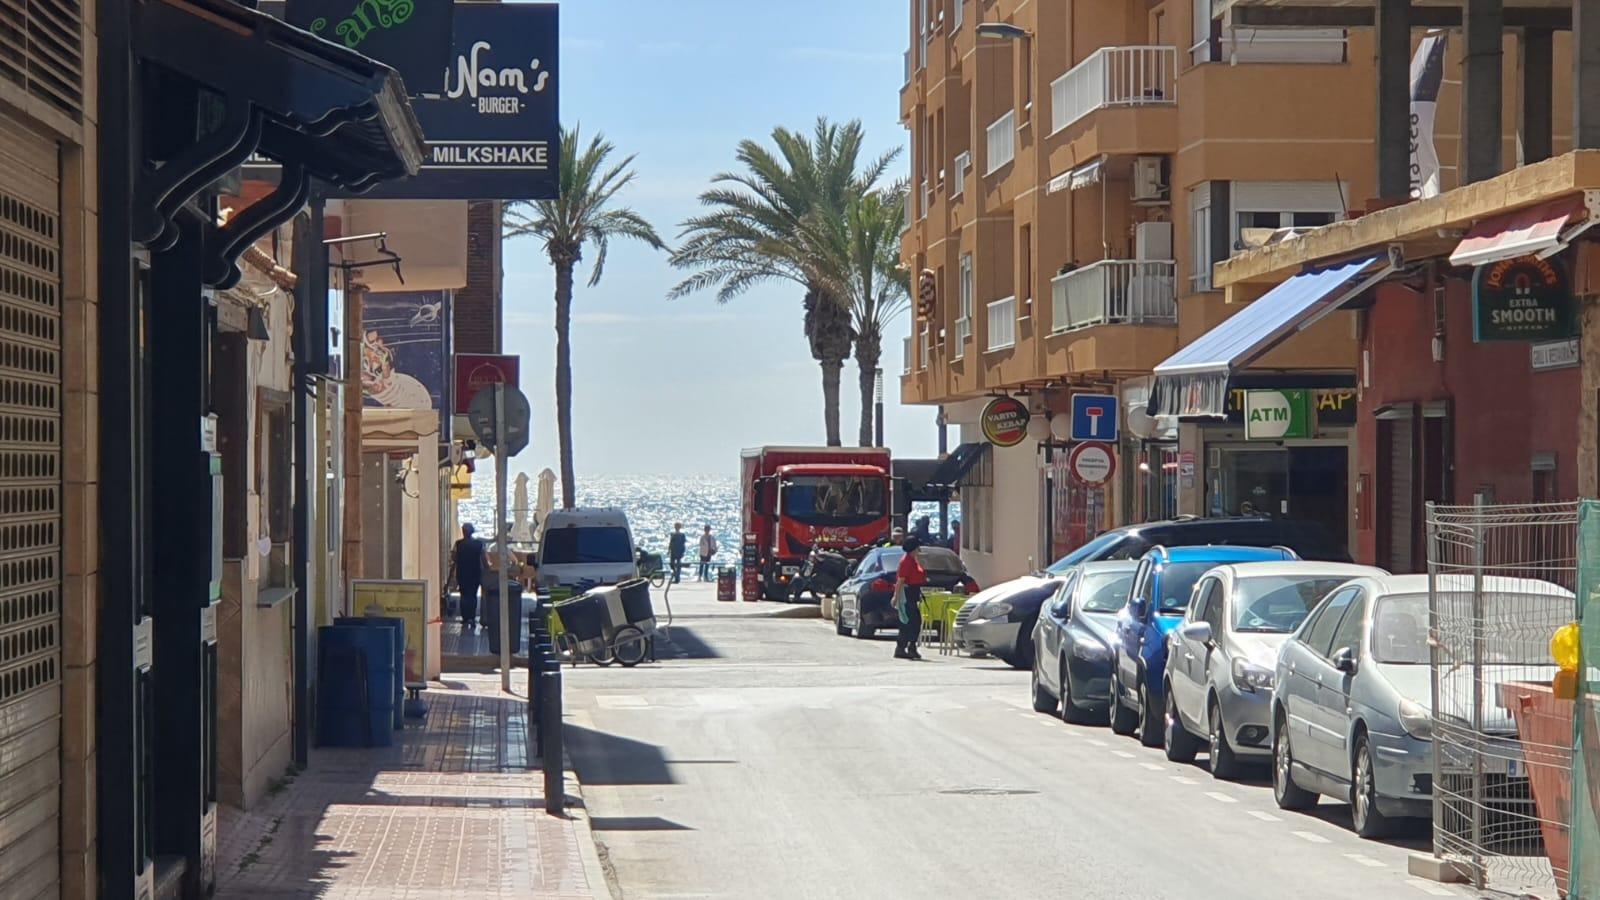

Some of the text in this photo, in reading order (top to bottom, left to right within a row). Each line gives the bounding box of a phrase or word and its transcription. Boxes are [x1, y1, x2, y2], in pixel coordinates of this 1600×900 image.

[447, 41, 549, 98] Nam's
[478, 97, 519, 113] BURGER
[433, 147, 548, 163] MILKSHAKE
[1509, 298, 1538, 308] EXTRA
[1491, 307, 1556, 324] SMOOTH
[1250, 407, 1289, 422] ATM
